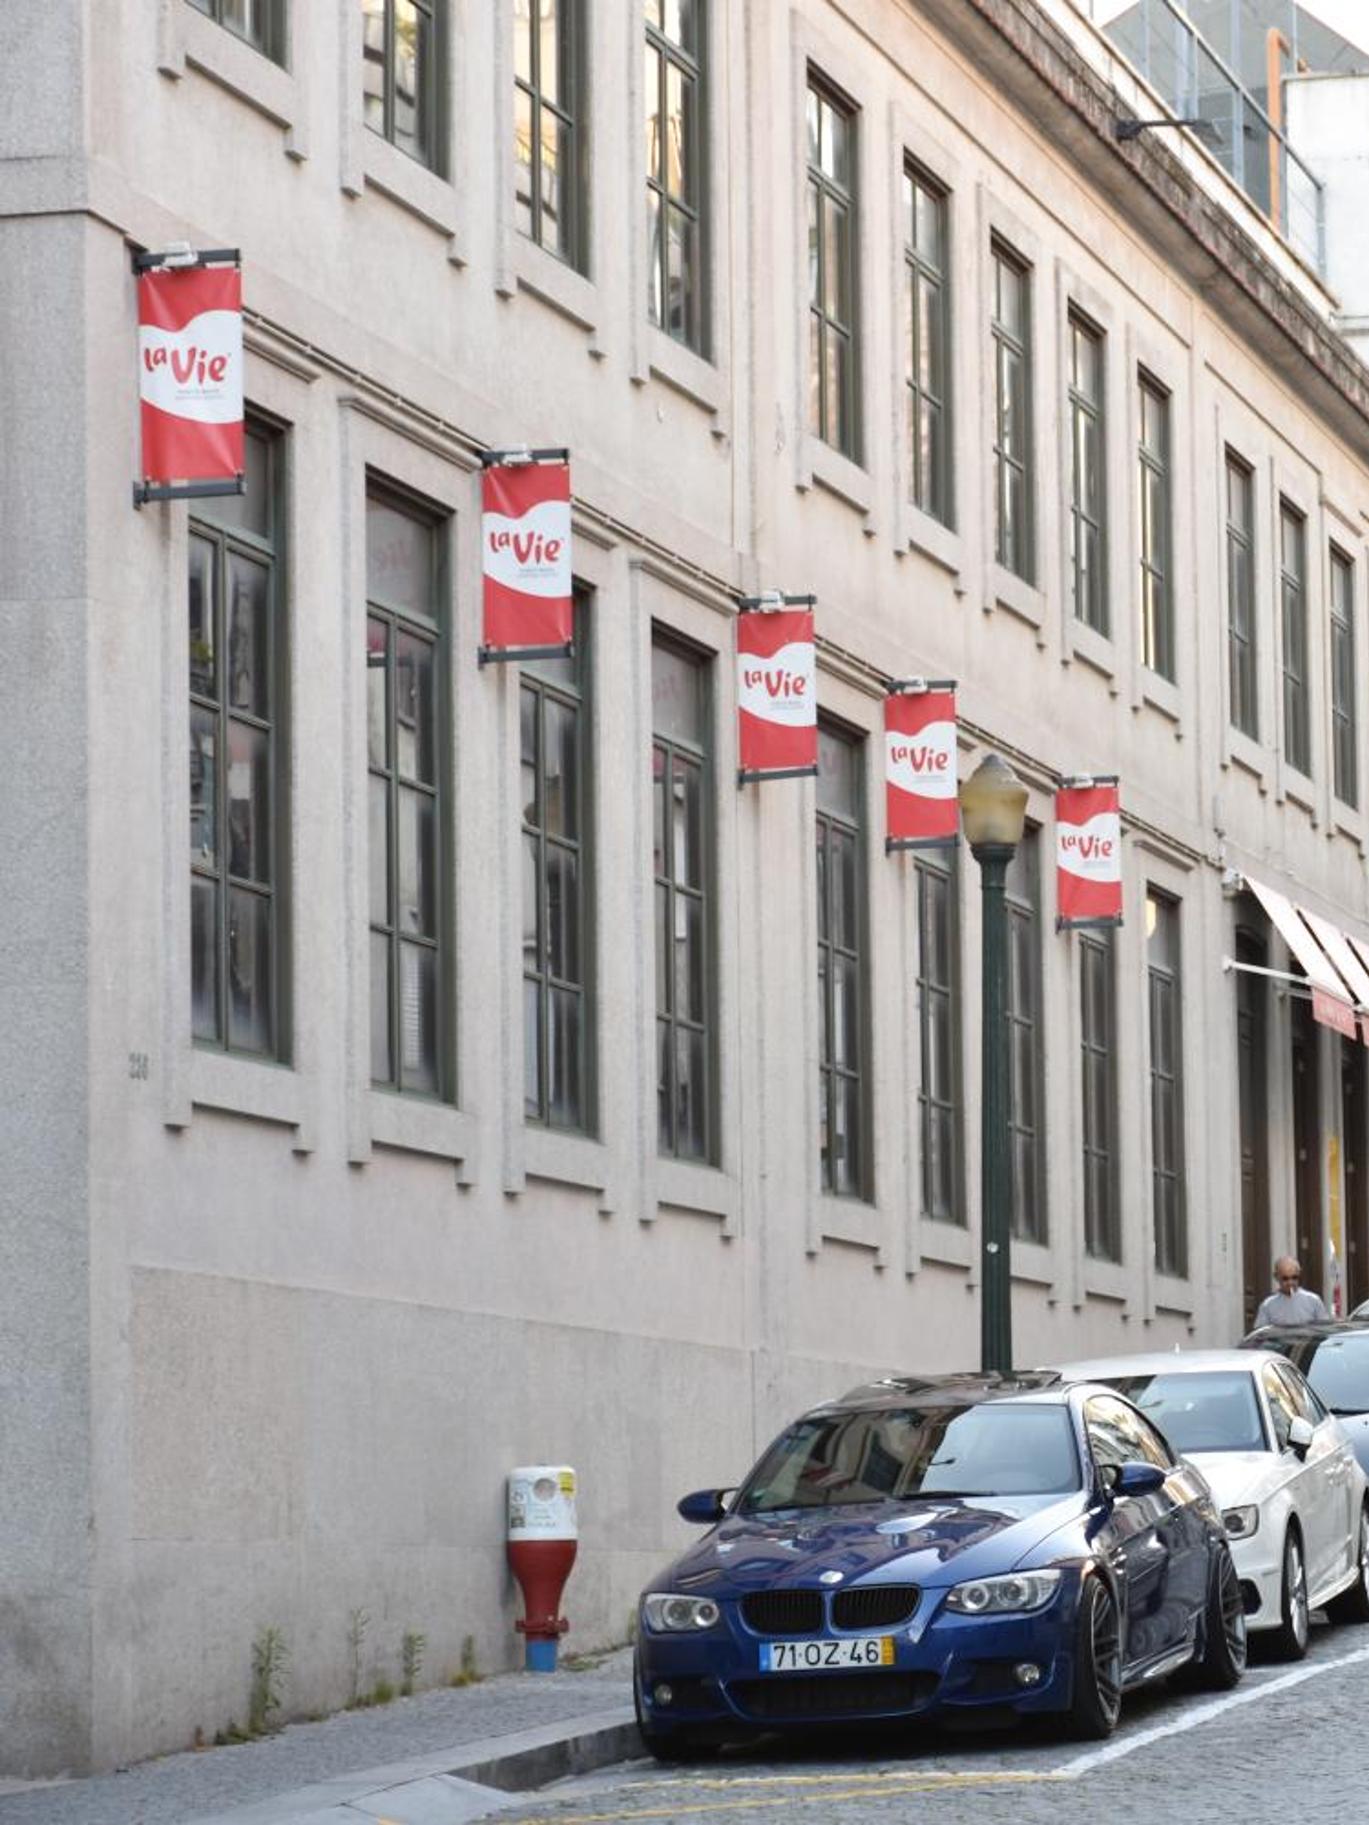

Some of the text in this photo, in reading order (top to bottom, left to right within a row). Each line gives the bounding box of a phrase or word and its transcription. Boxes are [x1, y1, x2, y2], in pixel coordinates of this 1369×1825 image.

[171, 346, 228, 385] Vie
[513, 530, 561, 564] Vie
[765, 668, 806, 698] Vie
[910, 746, 948, 773] Vie
